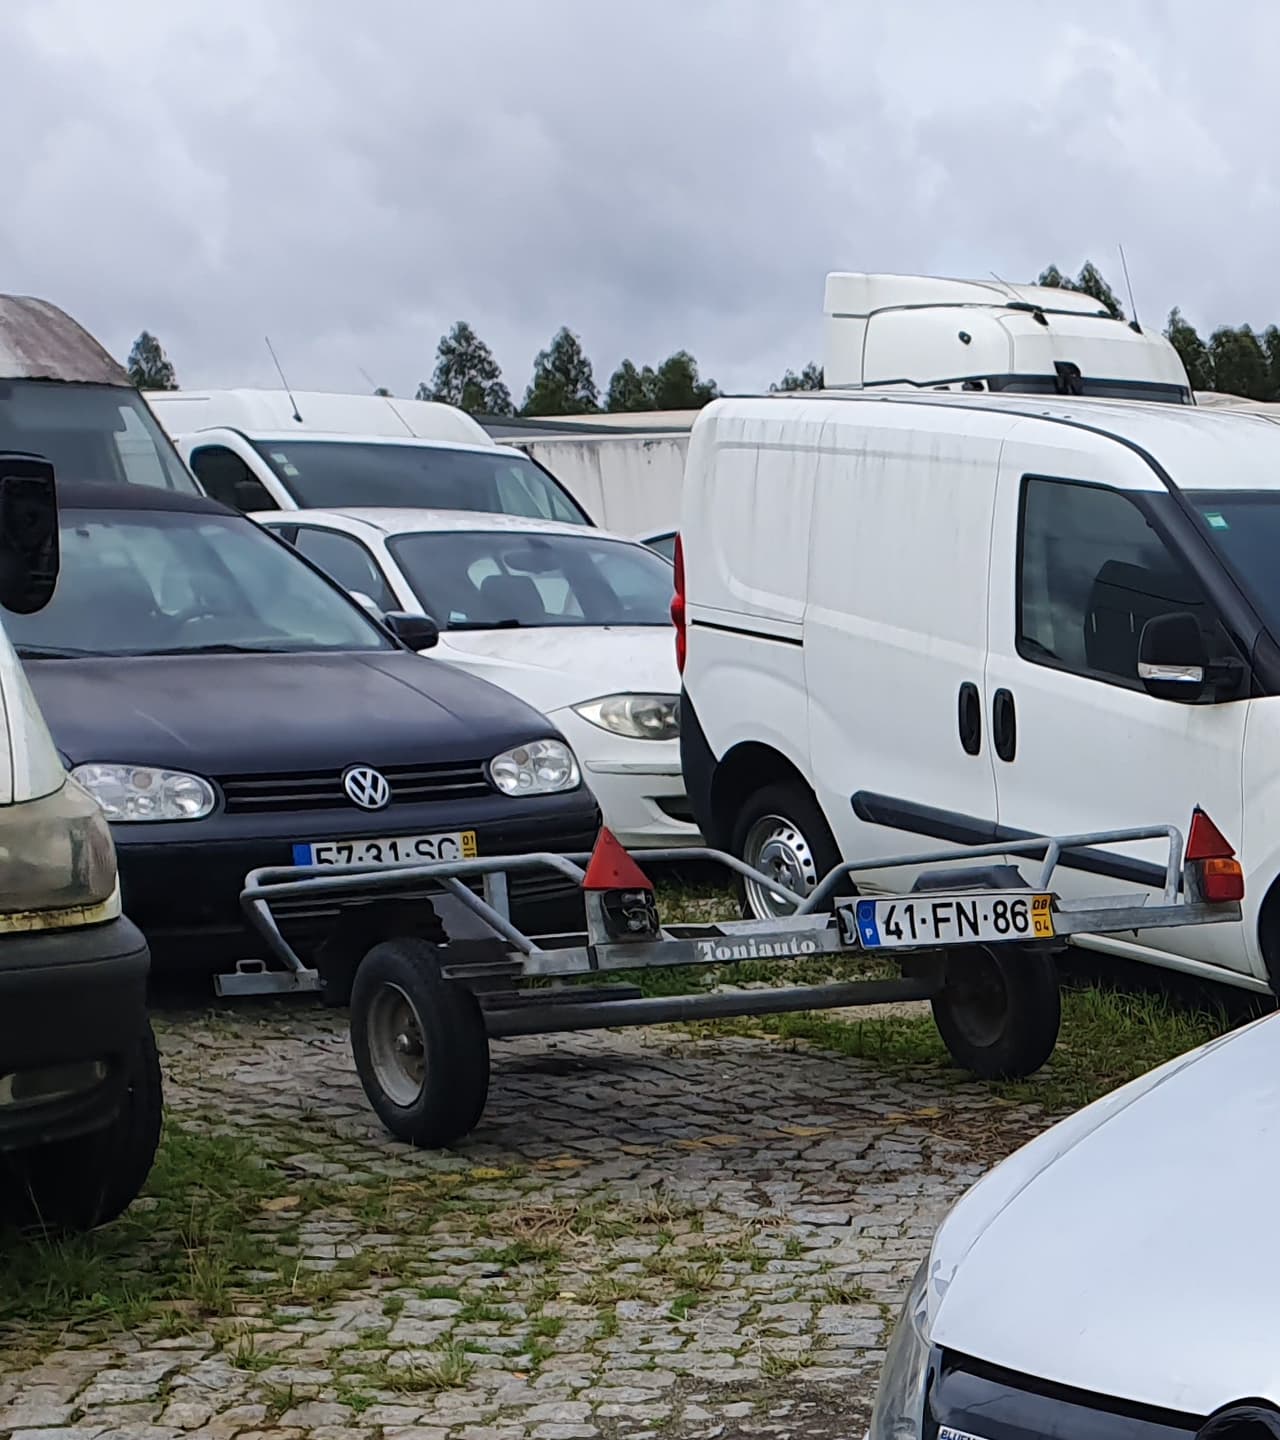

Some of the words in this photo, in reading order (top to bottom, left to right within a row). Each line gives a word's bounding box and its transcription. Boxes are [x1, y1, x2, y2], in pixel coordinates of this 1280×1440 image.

[1033, 899, 1048, 910] 08
[1034, 919, 1050, 932] 04
[864, 927, 874, 940] P
[697, 937, 817, 962] Toniauto
